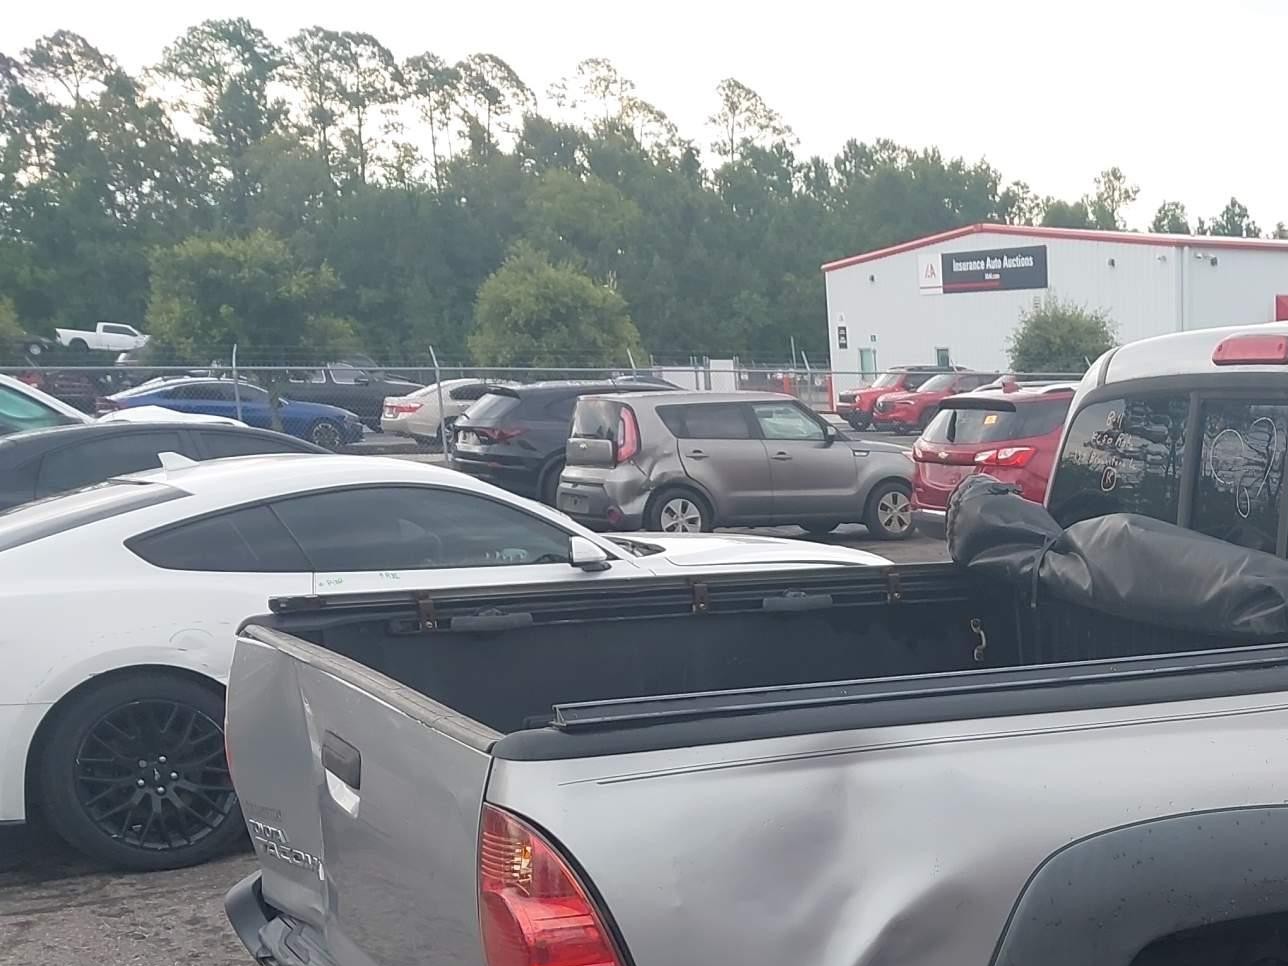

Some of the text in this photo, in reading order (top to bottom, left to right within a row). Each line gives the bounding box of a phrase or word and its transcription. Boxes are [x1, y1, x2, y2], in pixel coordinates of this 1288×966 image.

[953, 254, 1033, 271] Insurance Auto Auctions
